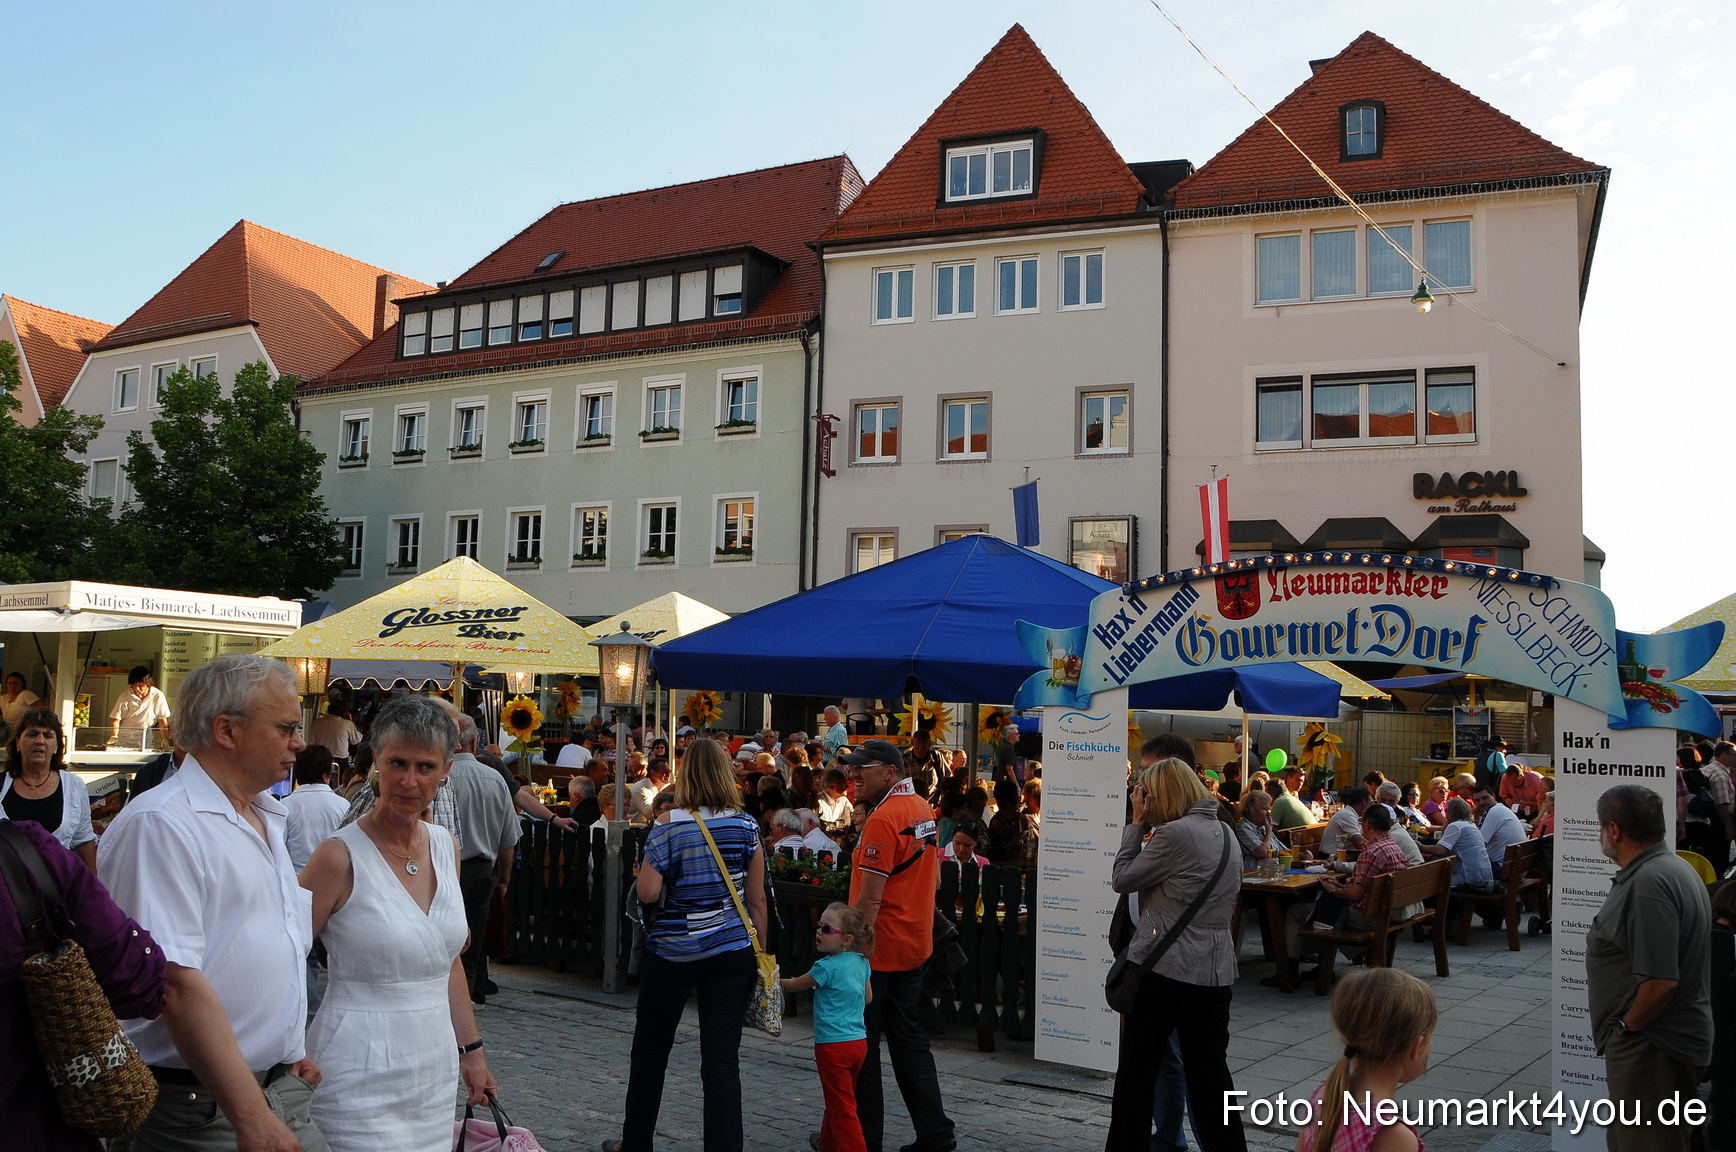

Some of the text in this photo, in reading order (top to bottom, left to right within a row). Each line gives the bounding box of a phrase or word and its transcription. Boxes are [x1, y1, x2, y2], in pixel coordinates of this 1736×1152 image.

[822, 427, 831, 470] Achatz
[1413, 470, 1527, 499] RACKL
[1427, 498, 1516, 513] am Rathaus
[1268, 567, 1449, 603] Neumarkter
[0, 593, 49, 607] Lachssemmel
[85, 592, 291, 622] Matjes- Bismarck- Lachssemmel
[378, 605, 529, 639] Glossner
[1528, 580, 1616, 668] SCHMIDT-
[456, 623, 526, 641] Bier
[1102, 581, 1200, 686] Liebermann
[1468, 577, 1593, 697] NIESSLBECK
[1048, 740, 1121, 753] Die Fischküche
[1066, 752, 1094, 762] Schmidt
[1563, 757, 1666, 778] Liebermann
[95, 780, 117, 794] Original
[1562, 854, 1616, 865] Schweinenack
[1560, 947, 1586, 957] Schasc
[1567, 1034, 1585, 1042] orig.
[1561, 1069, 1590, 1080] Portion
